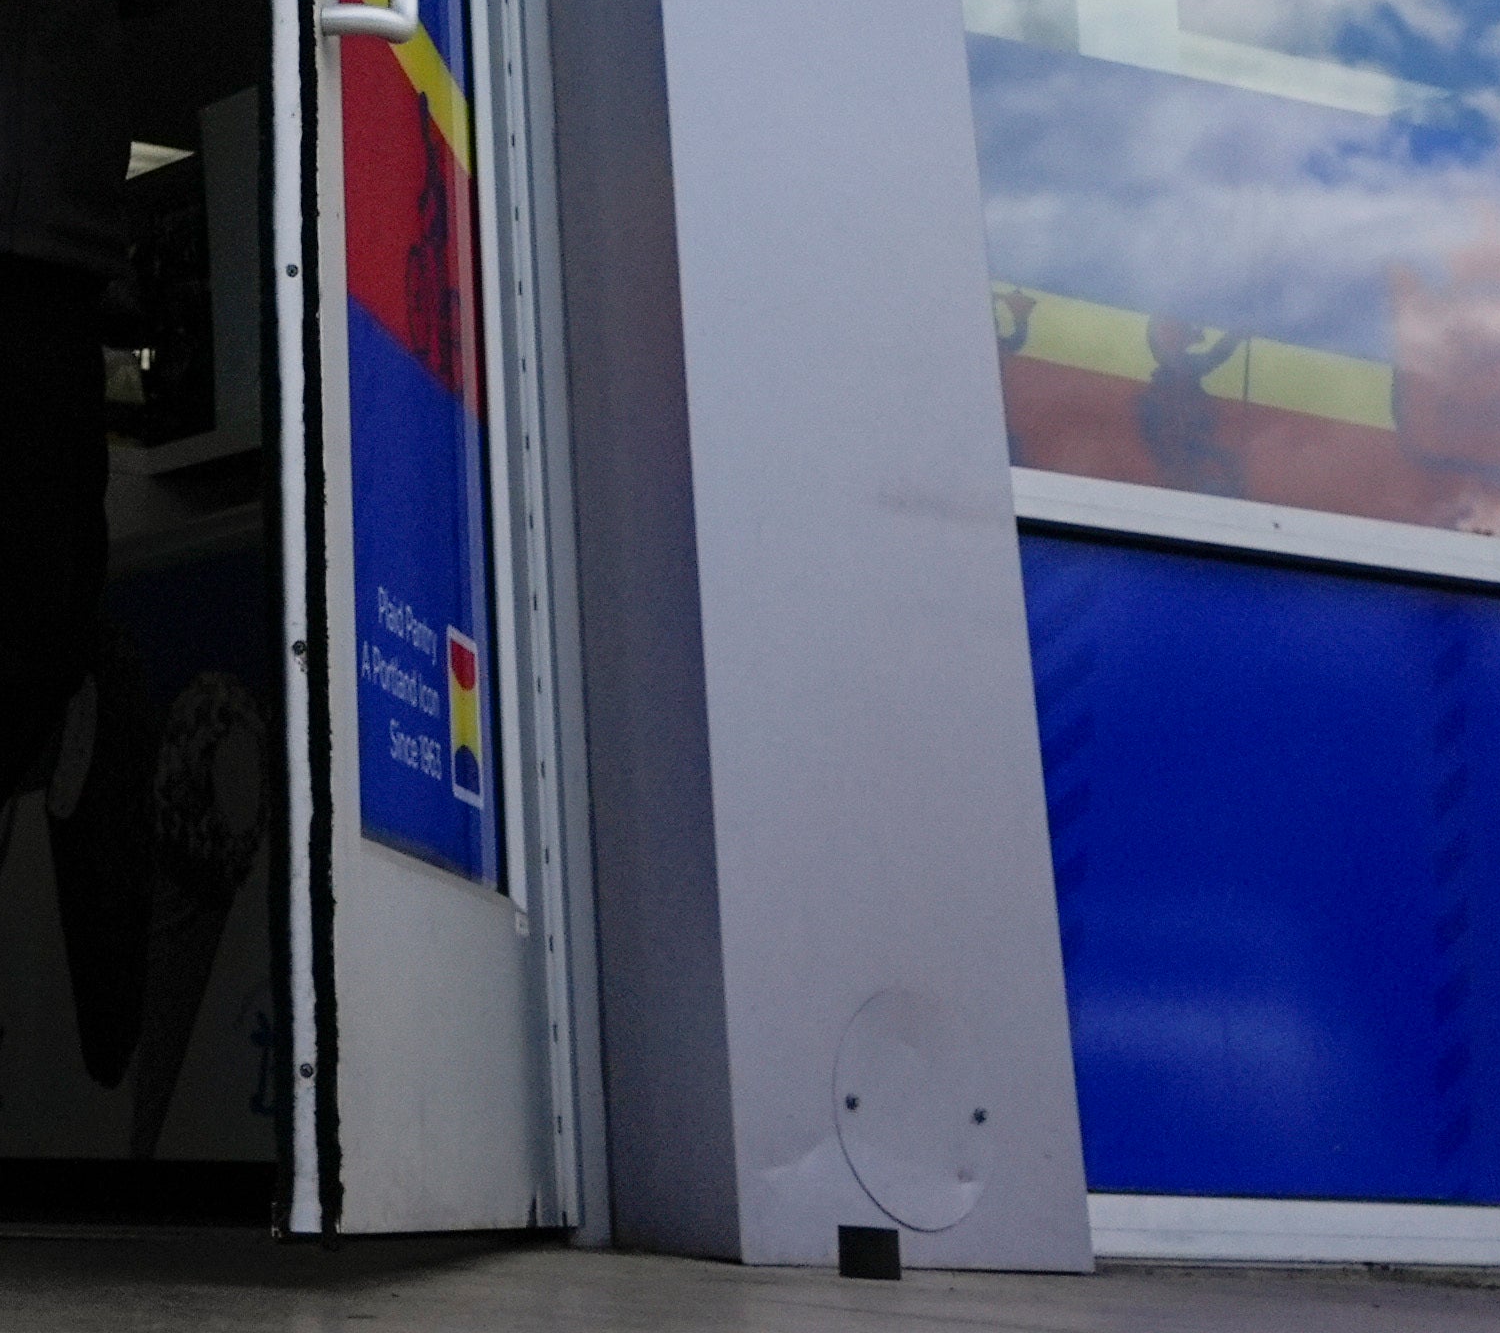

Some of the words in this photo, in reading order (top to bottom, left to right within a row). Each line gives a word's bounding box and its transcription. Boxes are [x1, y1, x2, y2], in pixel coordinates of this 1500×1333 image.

[377, 585, 405, 638] Plaid
[405, 604, 439, 667] Pantry
[361, 639, 371, 681] A
